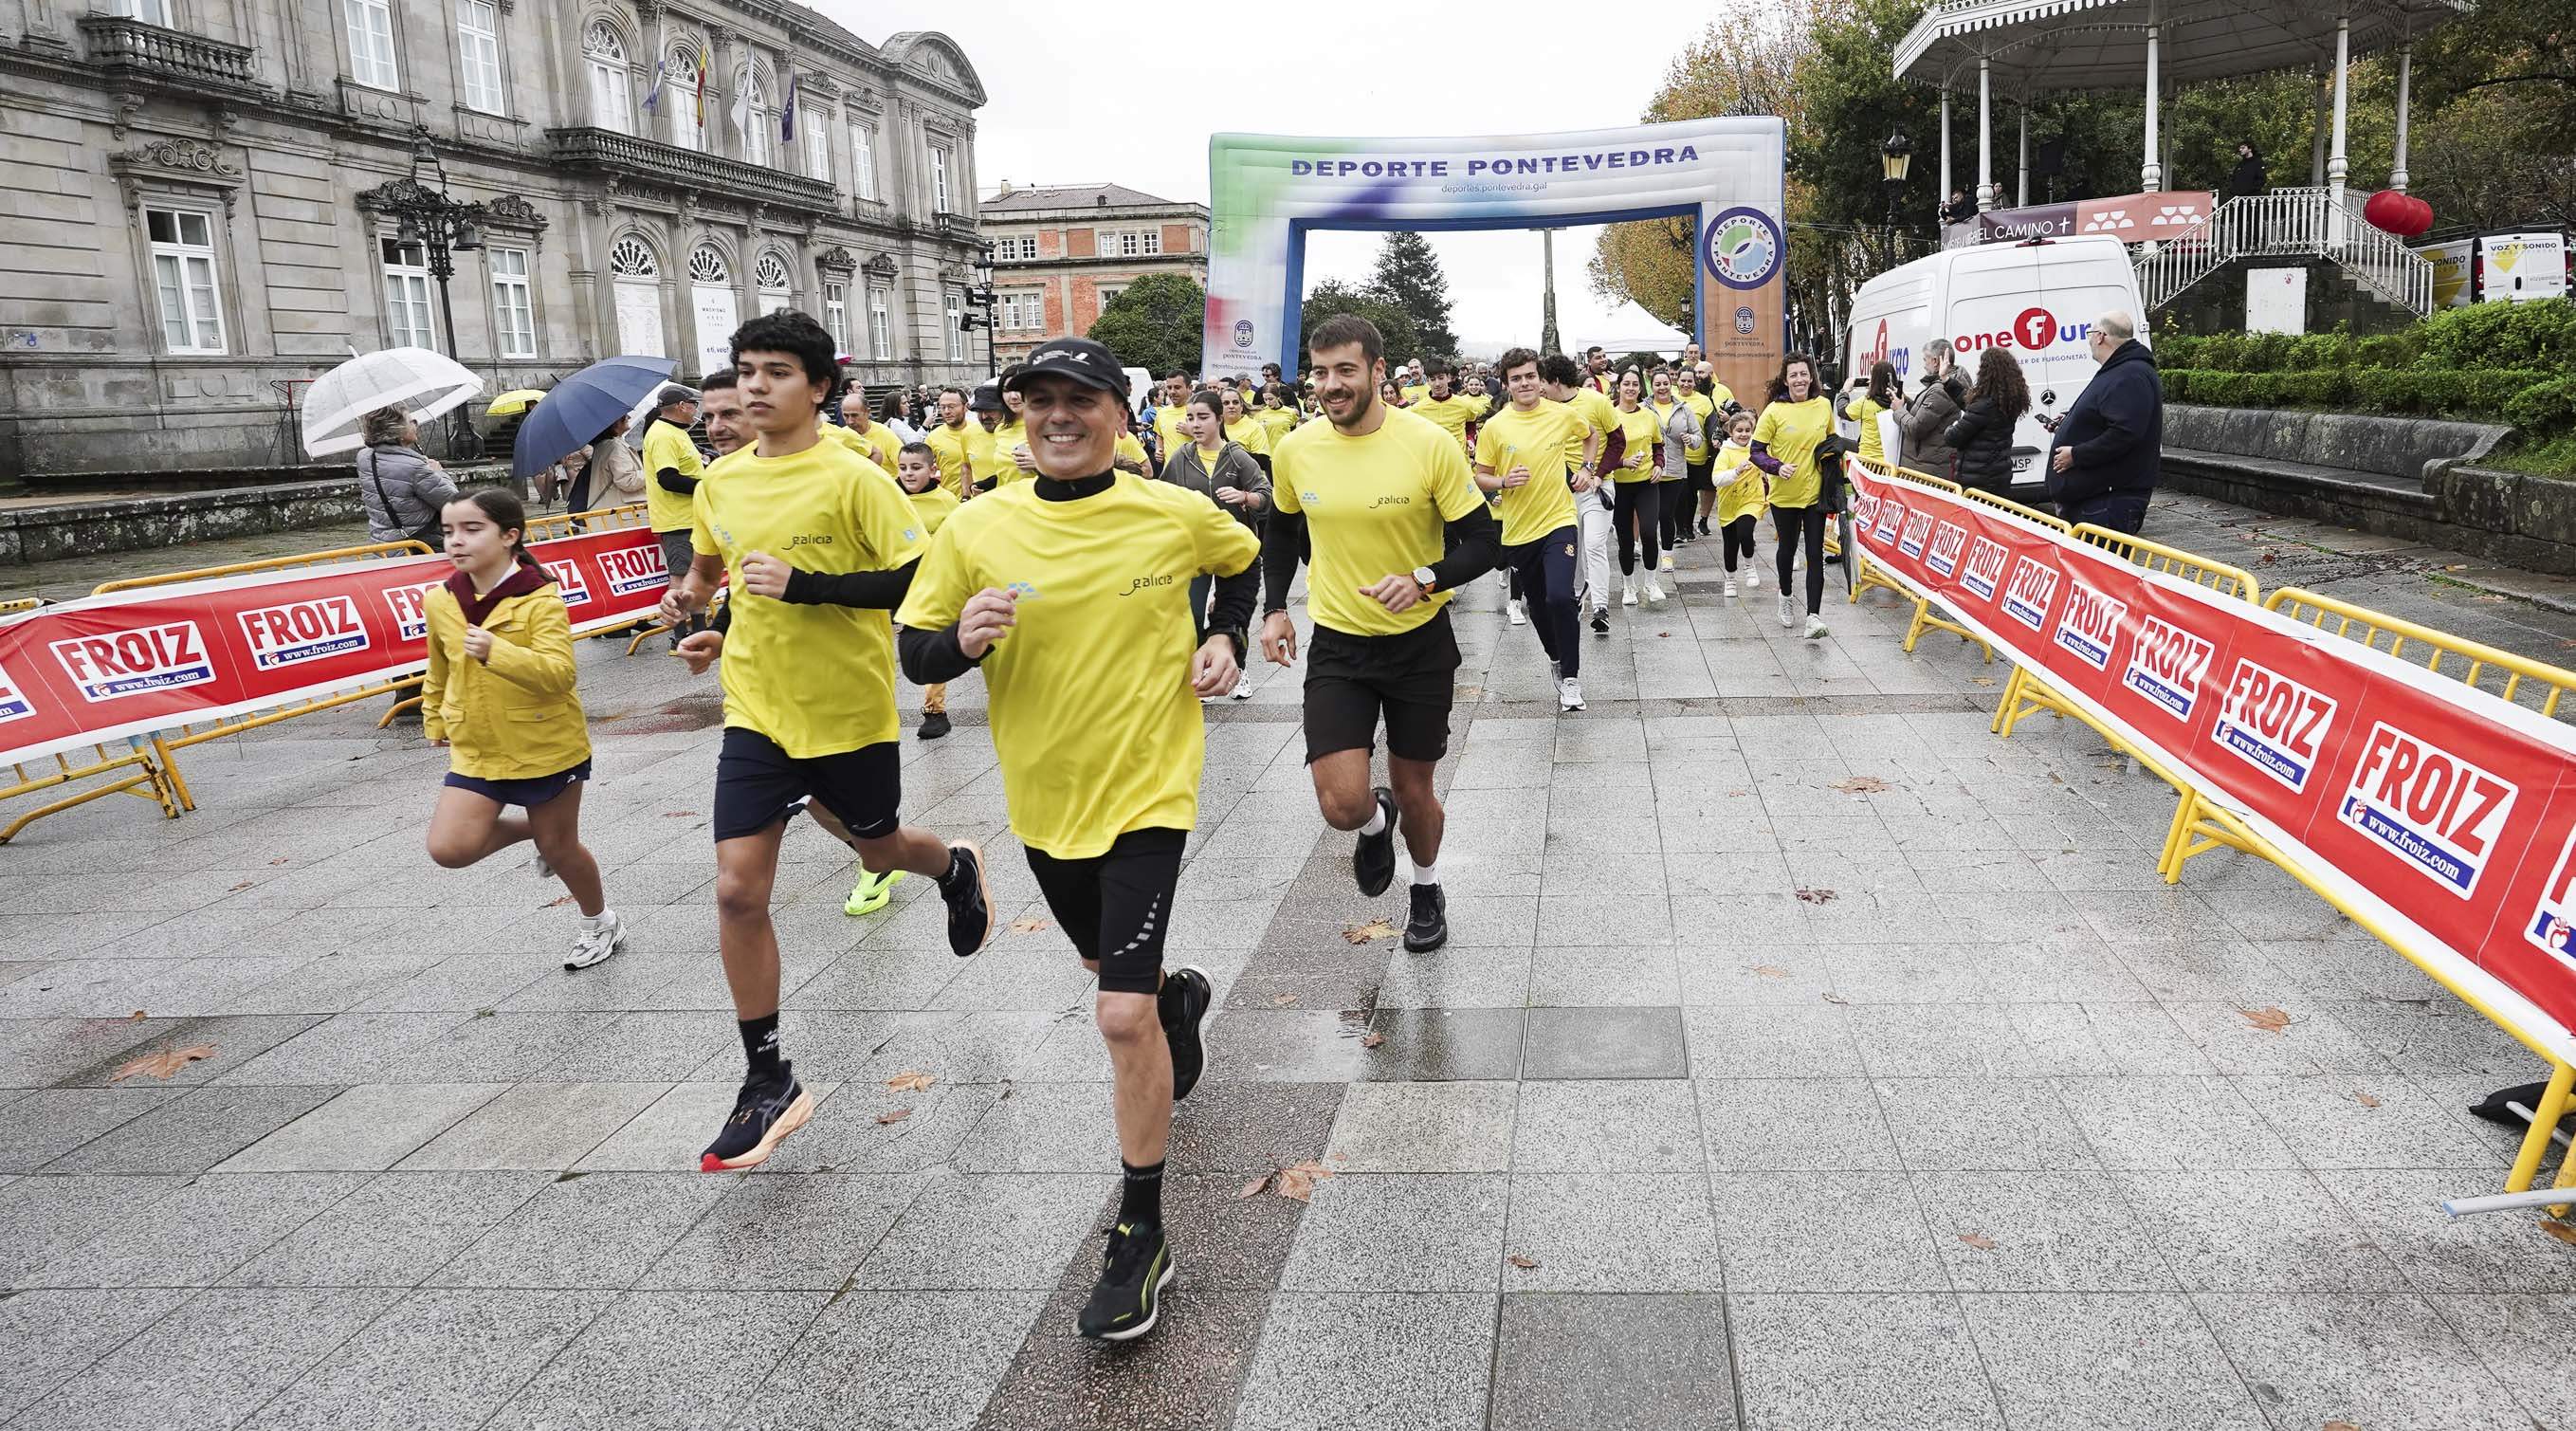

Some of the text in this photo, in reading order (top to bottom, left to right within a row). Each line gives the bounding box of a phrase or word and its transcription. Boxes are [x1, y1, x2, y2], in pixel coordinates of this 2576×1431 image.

[1291, 145, 1699, 177] DEPORTE PONTEVEDRA
[1441, 181, 1547, 194] deportes.pontevedra.gal
[1717, 217, 1769, 236] DEPORTE
[1994, 220, 2054, 240] CAMINO
[2522, 242, 2557, 250] SONIDO
[1713, 250, 1774, 280] PONTEVEDRA
[2041, 353, 2088, 364] FURGONETAS
[1368, 494, 1411, 509] galicia
[1879, 501, 1904, 531] FROIZ
[780, 534, 833, 551] galicia
[1904, 510, 1932, 544] FROIZ
[1931, 523, 1965, 560] FROIZ
[599, 546, 667, 581] FROIZ
[1967, 537, 2007, 582] FROIZ
[1118, 573, 1174, 596] galicia
[2009, 559, 2056, 611] FROIZ
[242, 598, 360, 651] FROIZ
[2063, 583, 2125, 647] FROIZ
[56, 624, 203, 682] FROIZ
[283, 638, 358, 661] www.froiz.com
[2133, 619, 2211, 694] FROIZ
[115, 670, 200, 692] www.froiz.com
[2138, 678, 2184, 711] www.froiz.com
[2224, 663, 2332, 760] FROIZ
[2232, 733, 2295, 780] www.froiz.com
[2355, 727, 2512, 857] FROIZ
[2367, 815, 2460, 880] www.froiz.com
